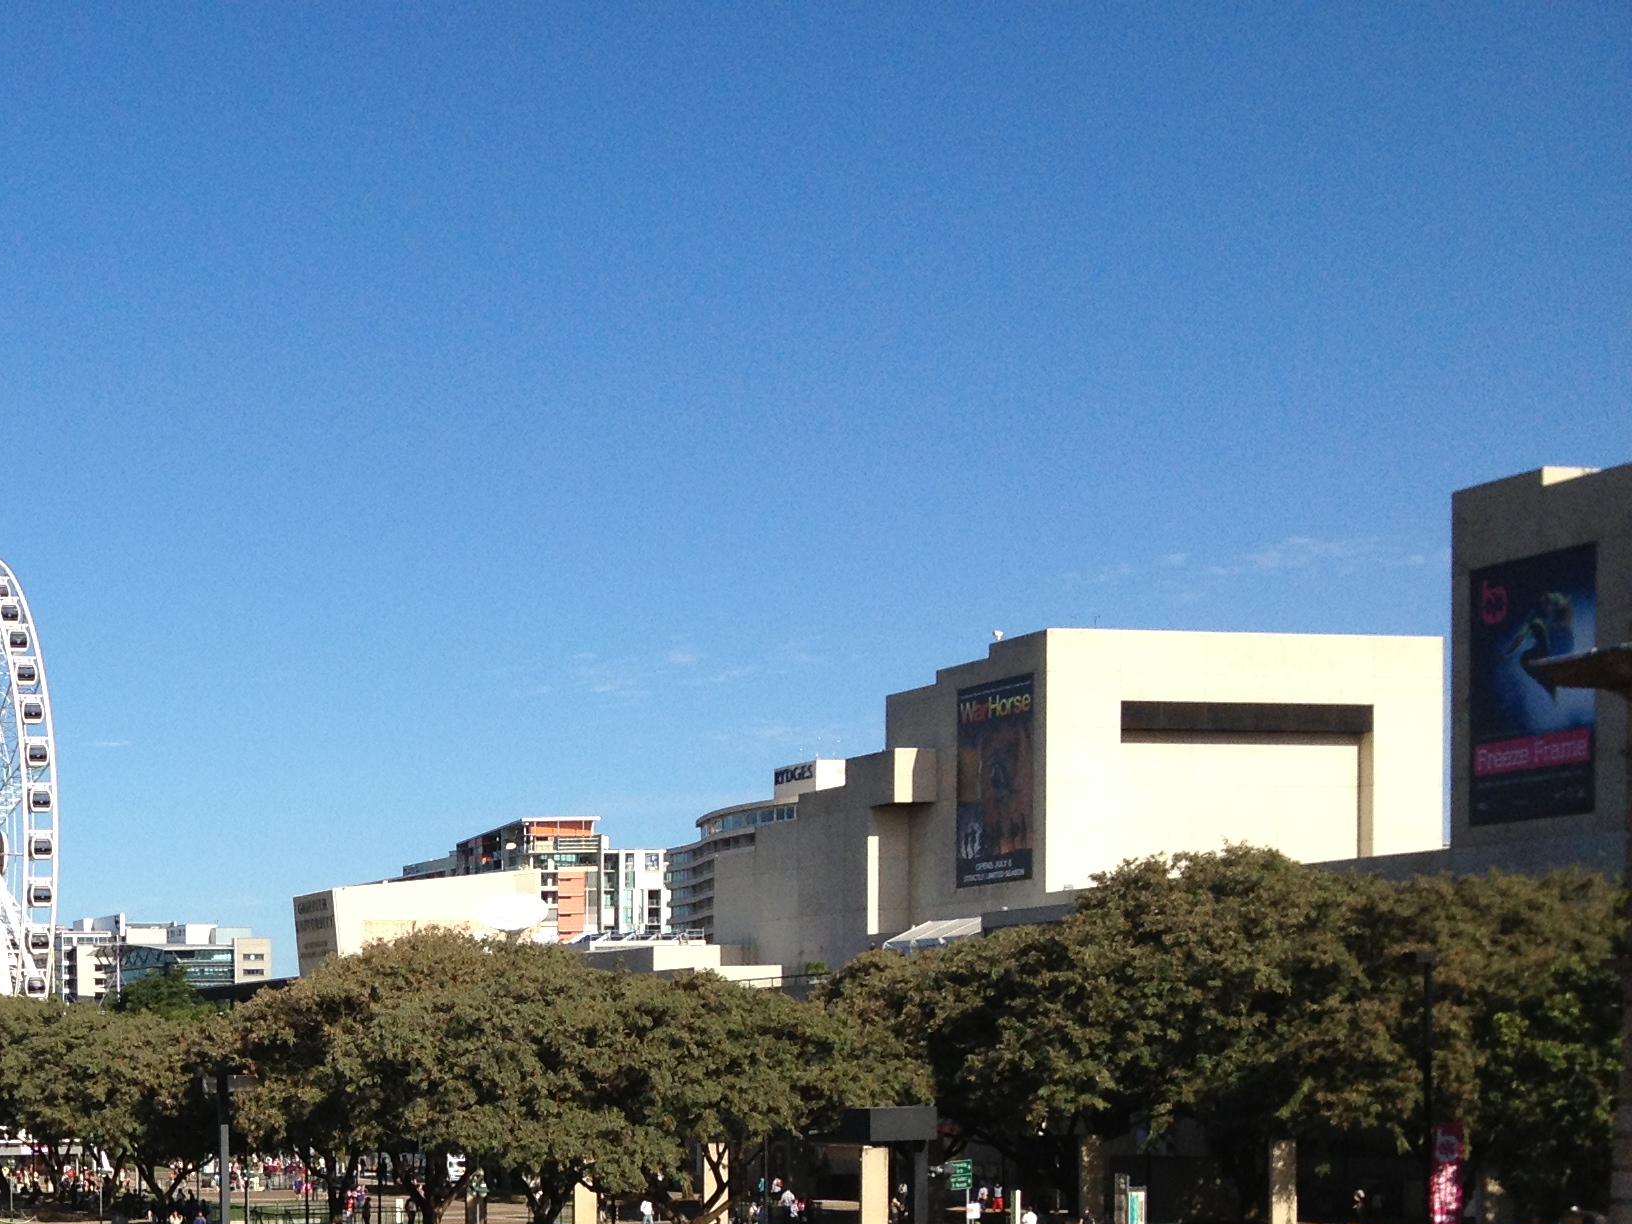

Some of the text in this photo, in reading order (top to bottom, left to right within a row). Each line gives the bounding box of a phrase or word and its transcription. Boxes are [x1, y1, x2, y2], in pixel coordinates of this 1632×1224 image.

[1477, 739, 1588, 770] Freeze Frame
[774, 764, 814, 786] RYDGES
[975, 861, 994, 871] OPENS
[995, 859, 1008, 869] JULY
[963, 867, 1025, 883] STRICTLY LIMITED SEASON
